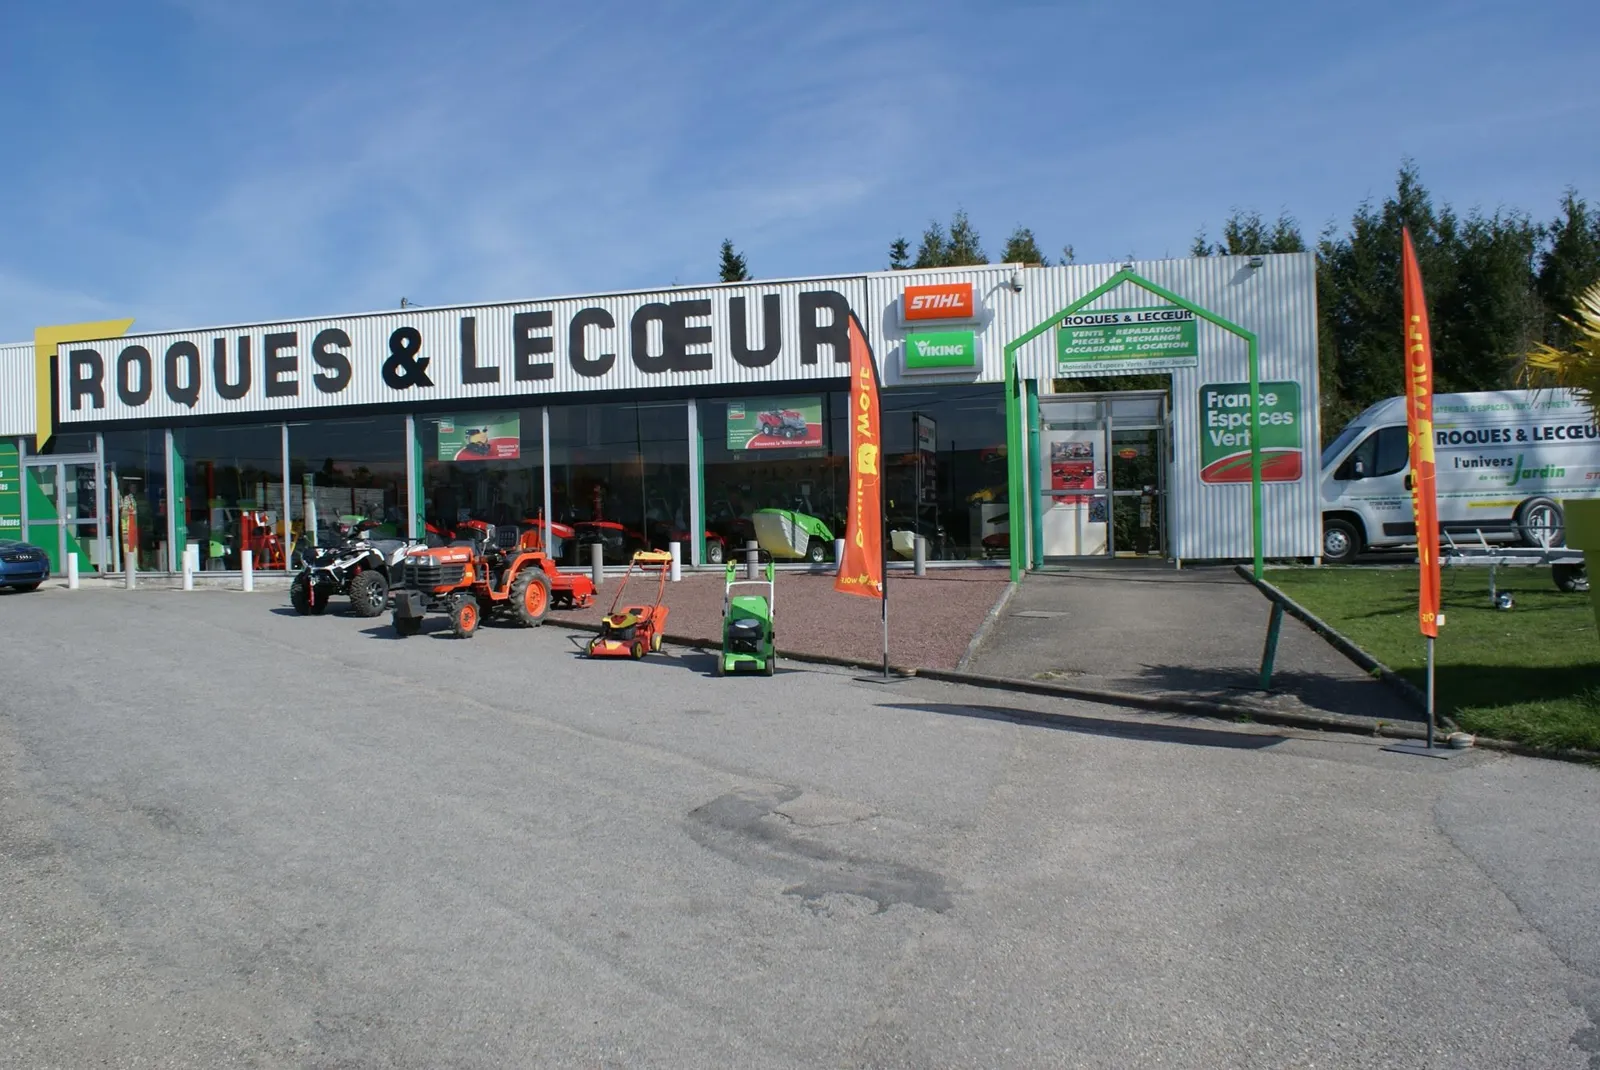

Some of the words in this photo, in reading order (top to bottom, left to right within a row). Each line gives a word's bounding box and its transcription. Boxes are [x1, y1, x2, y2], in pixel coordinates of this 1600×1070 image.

[910, 293, 964, 310] STIHL
[1064, 314, 1119, 326] ROQUES
[1123, 314, 1132, 322] &
[1137, 310, 1193, 322] LECŒUR
[1071, 330, 1104, 338] VENTE
[1115, 325, 1181, 336] REPARATION
[1071, 337, 1106, 346] PIECES
[1125, 333, 1181, 343] RECHANGE
[69, 328, 352, 410] ROQUES
[382, 326, 434, 390] &
[461, 290, 850, 384] LECŒUR
[917, 343, 964, 357] VIKING
[1065, 344, 1125, 354] OCCASIONS
[1136, 341, 1189, 351] LOCATION
[1209, 429, 1251, 447] Vert
[1436, 428, 1511, 446] ROQUES
[1515, 428, 1528, 442] &
[1533, 425, 1600, 441] LECŒU
[1454, 455, 1514, 468] l'univers
[1505, 453, 1566, 487] Jardin
